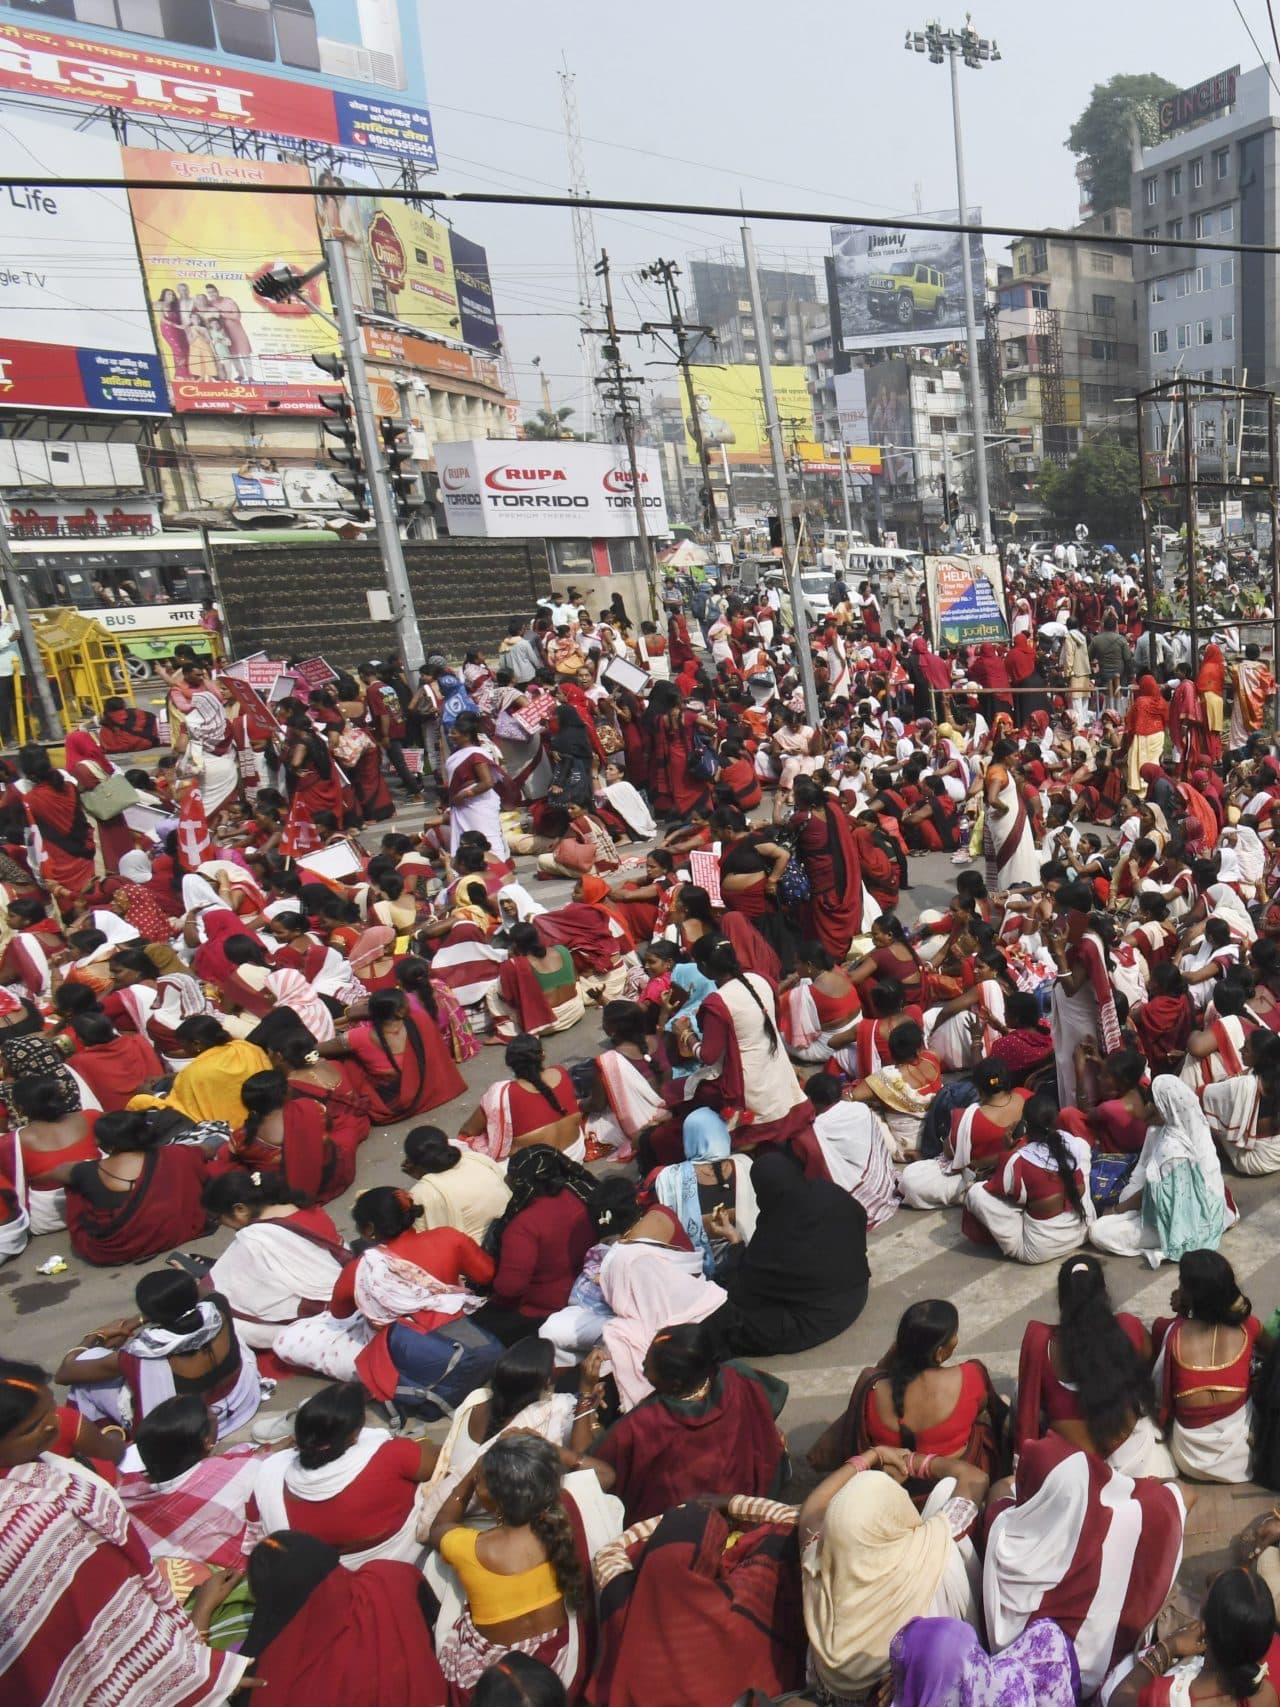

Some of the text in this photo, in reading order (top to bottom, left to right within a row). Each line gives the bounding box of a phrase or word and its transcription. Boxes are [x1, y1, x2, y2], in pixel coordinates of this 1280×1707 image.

[1160, 72, 1237, 128] GINGER
[8, 185, 58, 215] Life
[868, 233, 906, 251] Jimny
[22, 270, 46, 288] TV
[448, 467, 471, 479] RUPA
[505, 468, 568, 481] RUPA
[445, 493, 481, 506] TORRIDO
[487, 494, 590, 508] TORRIDO
[105, 614, 137, 627] BUS
[168, 610, 194, 622] नगर
